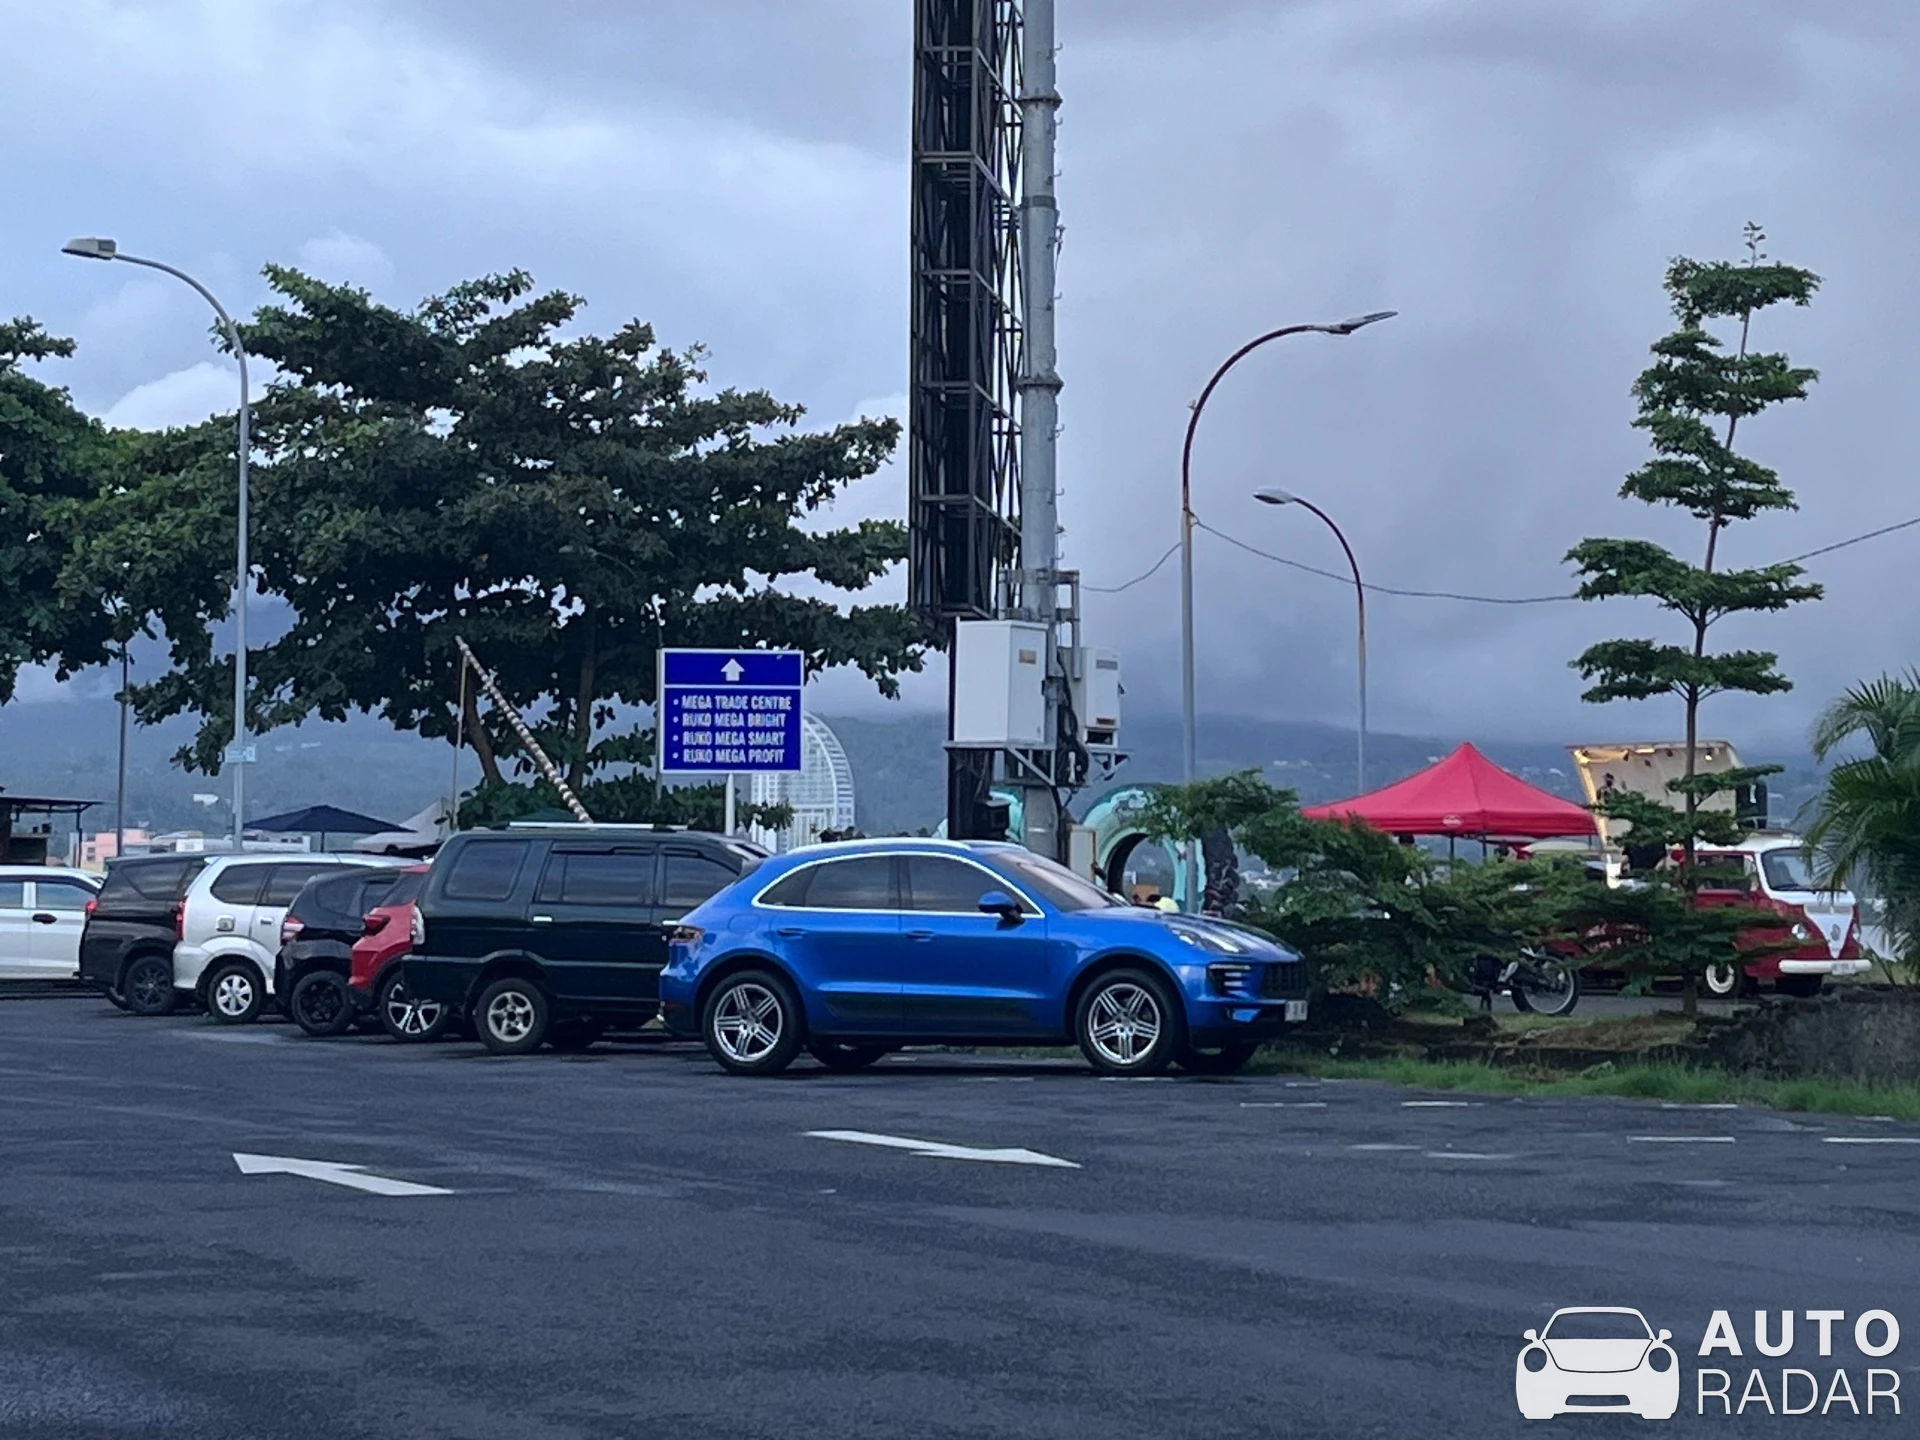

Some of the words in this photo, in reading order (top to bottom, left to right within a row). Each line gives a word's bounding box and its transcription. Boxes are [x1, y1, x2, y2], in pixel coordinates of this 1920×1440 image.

[681, 695, 712, 709] MEGA
[714, 695, 748, 709] TRADE
[751, 696, 792, 710] CENTRE
[682, 713, 711, 727] RUKO
[714, 713, 746, 727] MEGA
[748, 713, 786, 727] BRIGHT
[682, 731, 712, 745] RUKO
[714, 731, 746, 745] MEGA
[748, 731, 785, 745] SMART
[683, 749, 713, 763] RUKO
[715, 749, 746, 763] MEGA
[748, 749, 785, 763] PROFIT
